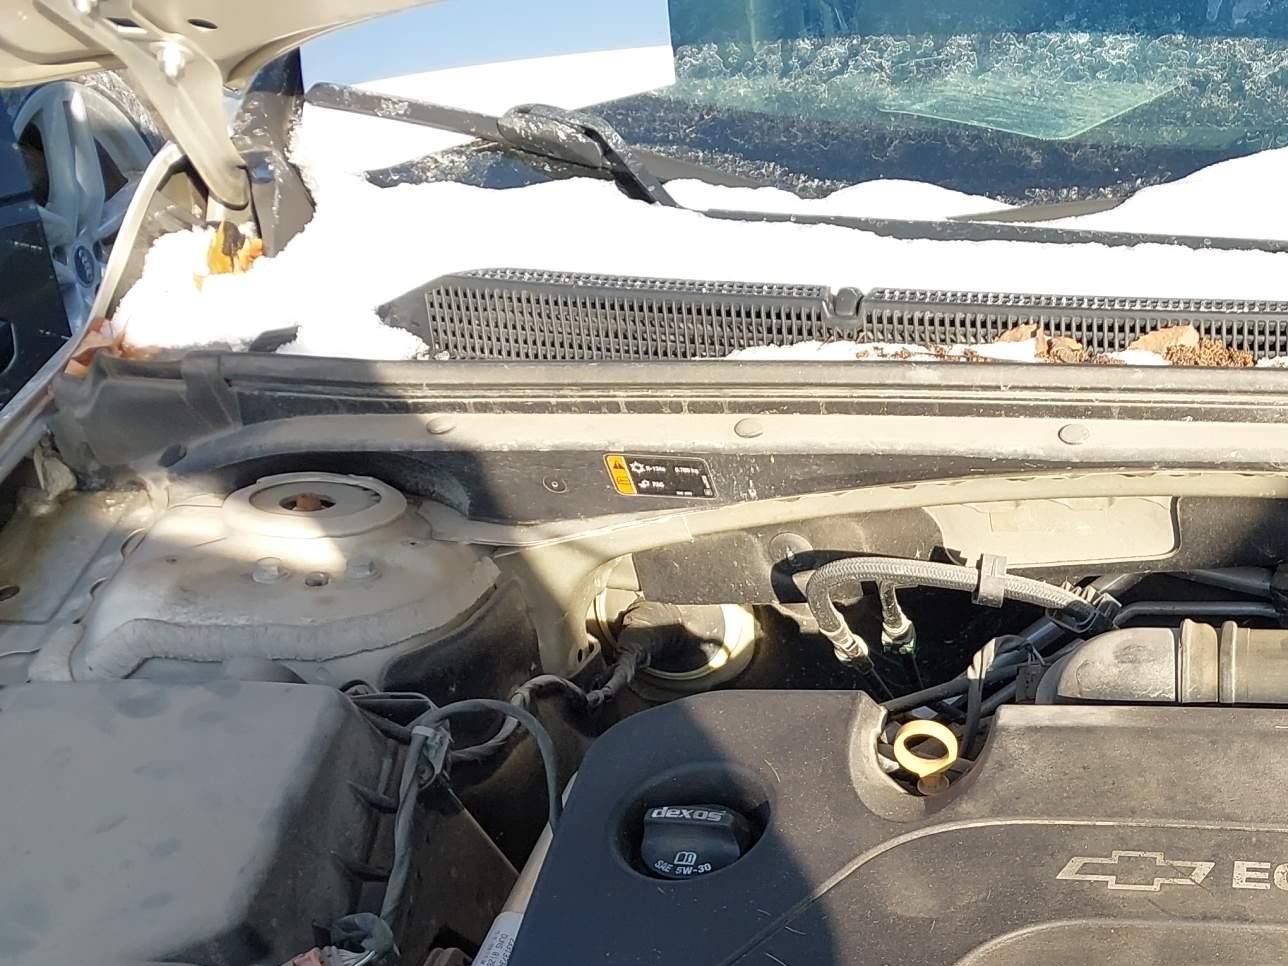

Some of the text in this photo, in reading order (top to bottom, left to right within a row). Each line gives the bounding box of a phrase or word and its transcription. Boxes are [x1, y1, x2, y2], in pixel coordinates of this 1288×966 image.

[651, 806, 722, 822] dexos
[654, 859, 712, 875] SAE 5W-30
